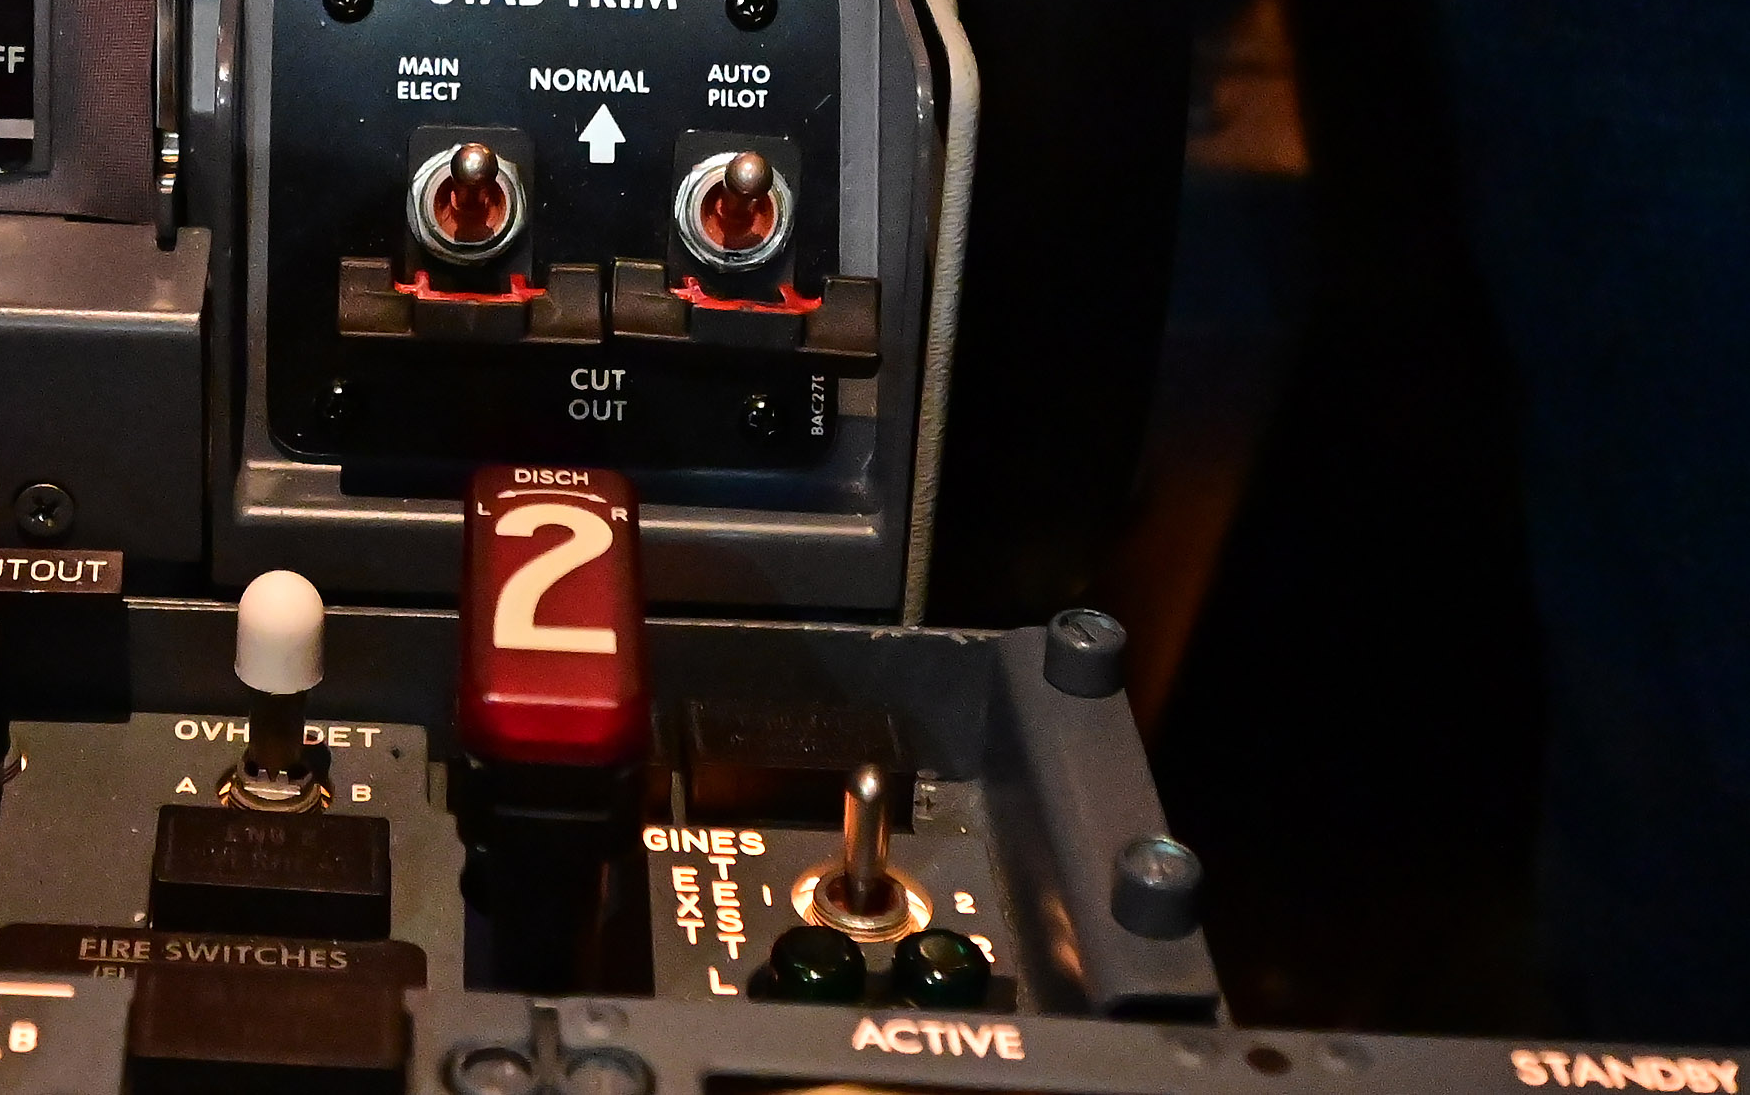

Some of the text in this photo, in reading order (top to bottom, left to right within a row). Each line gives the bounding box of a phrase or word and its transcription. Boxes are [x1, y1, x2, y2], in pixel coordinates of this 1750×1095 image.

[397, 57, 460, 78] MAIN
[707, 64, 771, 85] AUTO
[396, 81, 461, 102] ELECT
[529, 68, 650, 94] NORMAL
[707, 89, 768, 109] PILOT
[570, 369, 626, 391] CUT
[568, 399, 627, 422] OUT
[514, 468, 590, 486] DISCH
[477, 502, 492, 517] L
[610, 506, 629, 522] R
[493, 503, 618, 655] 2
[303, 725, 382, 748] DET
[175, 776, 198, 795] A
[351, 784, 372, 802] B
[642, 827, 766, 856] GINES
[671, 866, 706, 945] EXT
[708, 855, 746, 960] TEST
[953, 891, 977, 915] 2
[79, 938, 348, 969] FIRE SWITCHES
[708, 966, 738, 995] L
[8, 1021, 39, 1053] B
[851, 1018, 1026, 1061] ACTIVE
[1510, 1049, 1739, 1094] STANDBY
